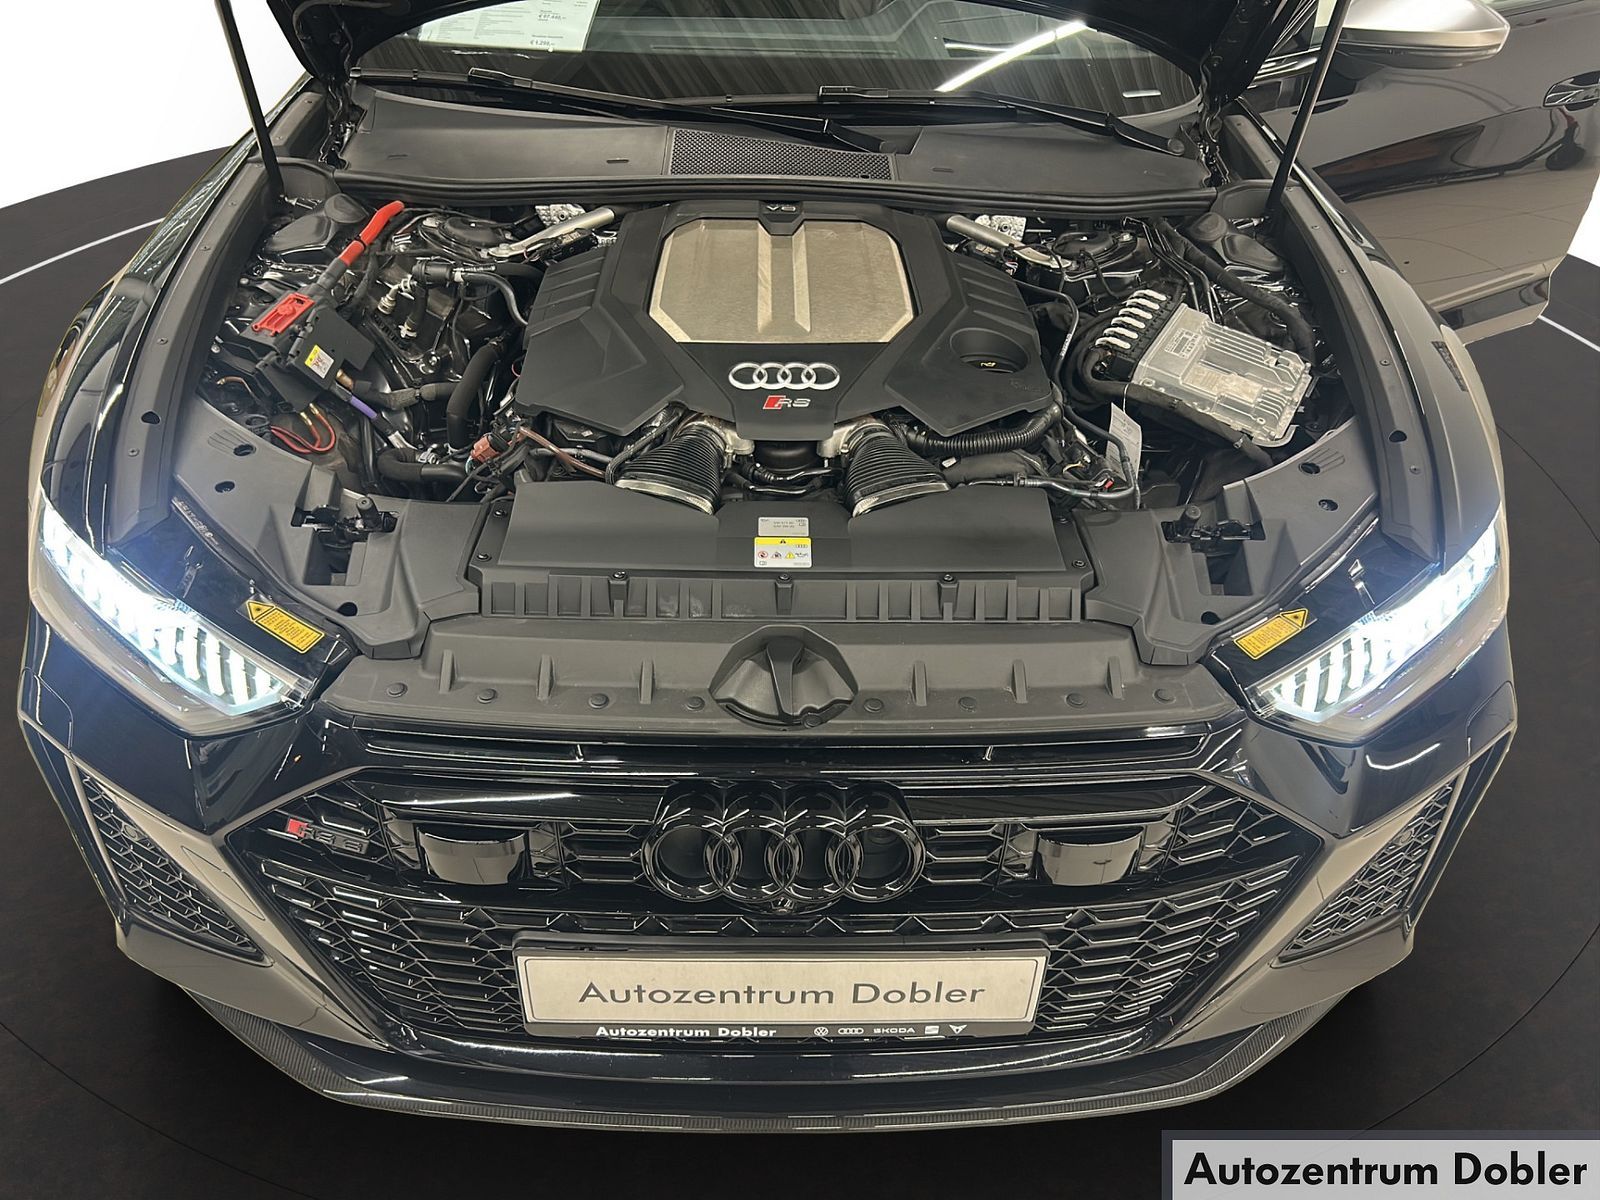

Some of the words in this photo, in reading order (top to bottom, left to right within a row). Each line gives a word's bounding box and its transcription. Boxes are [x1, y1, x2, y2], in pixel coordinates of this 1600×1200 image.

[767, 396, 811, 408] RS
[580, 982, 834, 1004] Autozentrum
[852, 981, 986, 1004] Dobler
[596, 1026, 710, 1037] Autozentrum
[718, 1026, 777, 1037] Dobler
